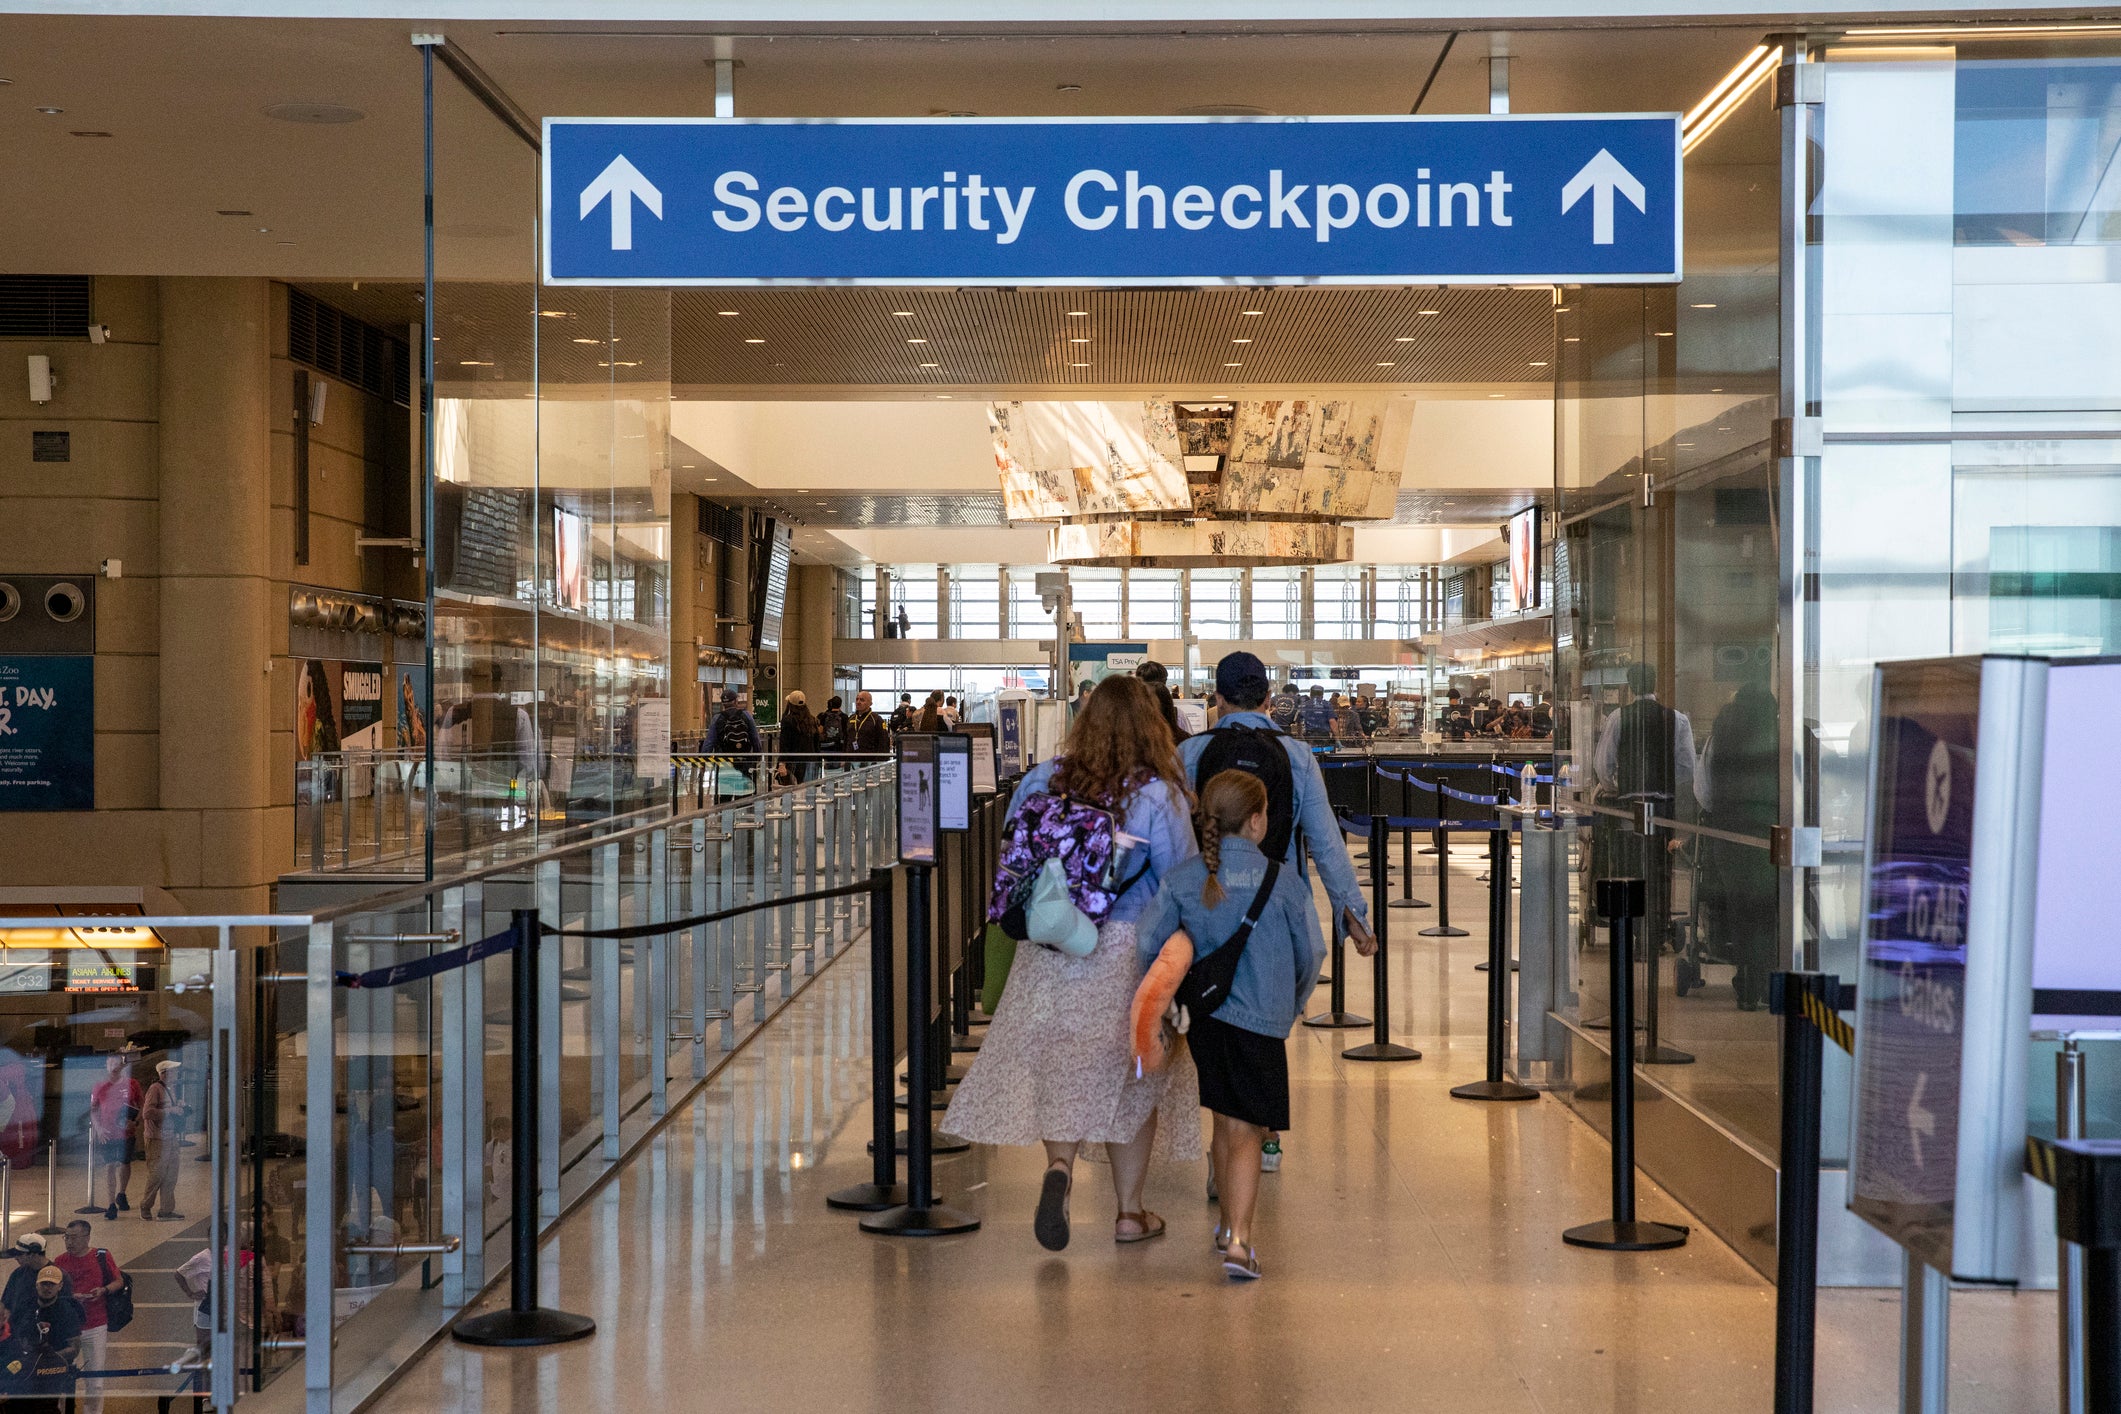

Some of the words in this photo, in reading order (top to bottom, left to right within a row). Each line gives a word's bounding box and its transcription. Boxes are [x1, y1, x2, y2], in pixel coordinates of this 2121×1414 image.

[713, 170, 1035, 244] Security
[1065, 169, 1512, 242] Checkpoint
[2, 666, 19, 674] Zoo
[15, 686, 57, 710] DAY.
[343, 671, 381, 701] SMUGGLED
[17, 975, 43, 987] C32
[72, 967, 98, 976] ASIANA
[101, 967, 132, 976] AIRLINES
[1901, 957, 1956, 1034] Gates
